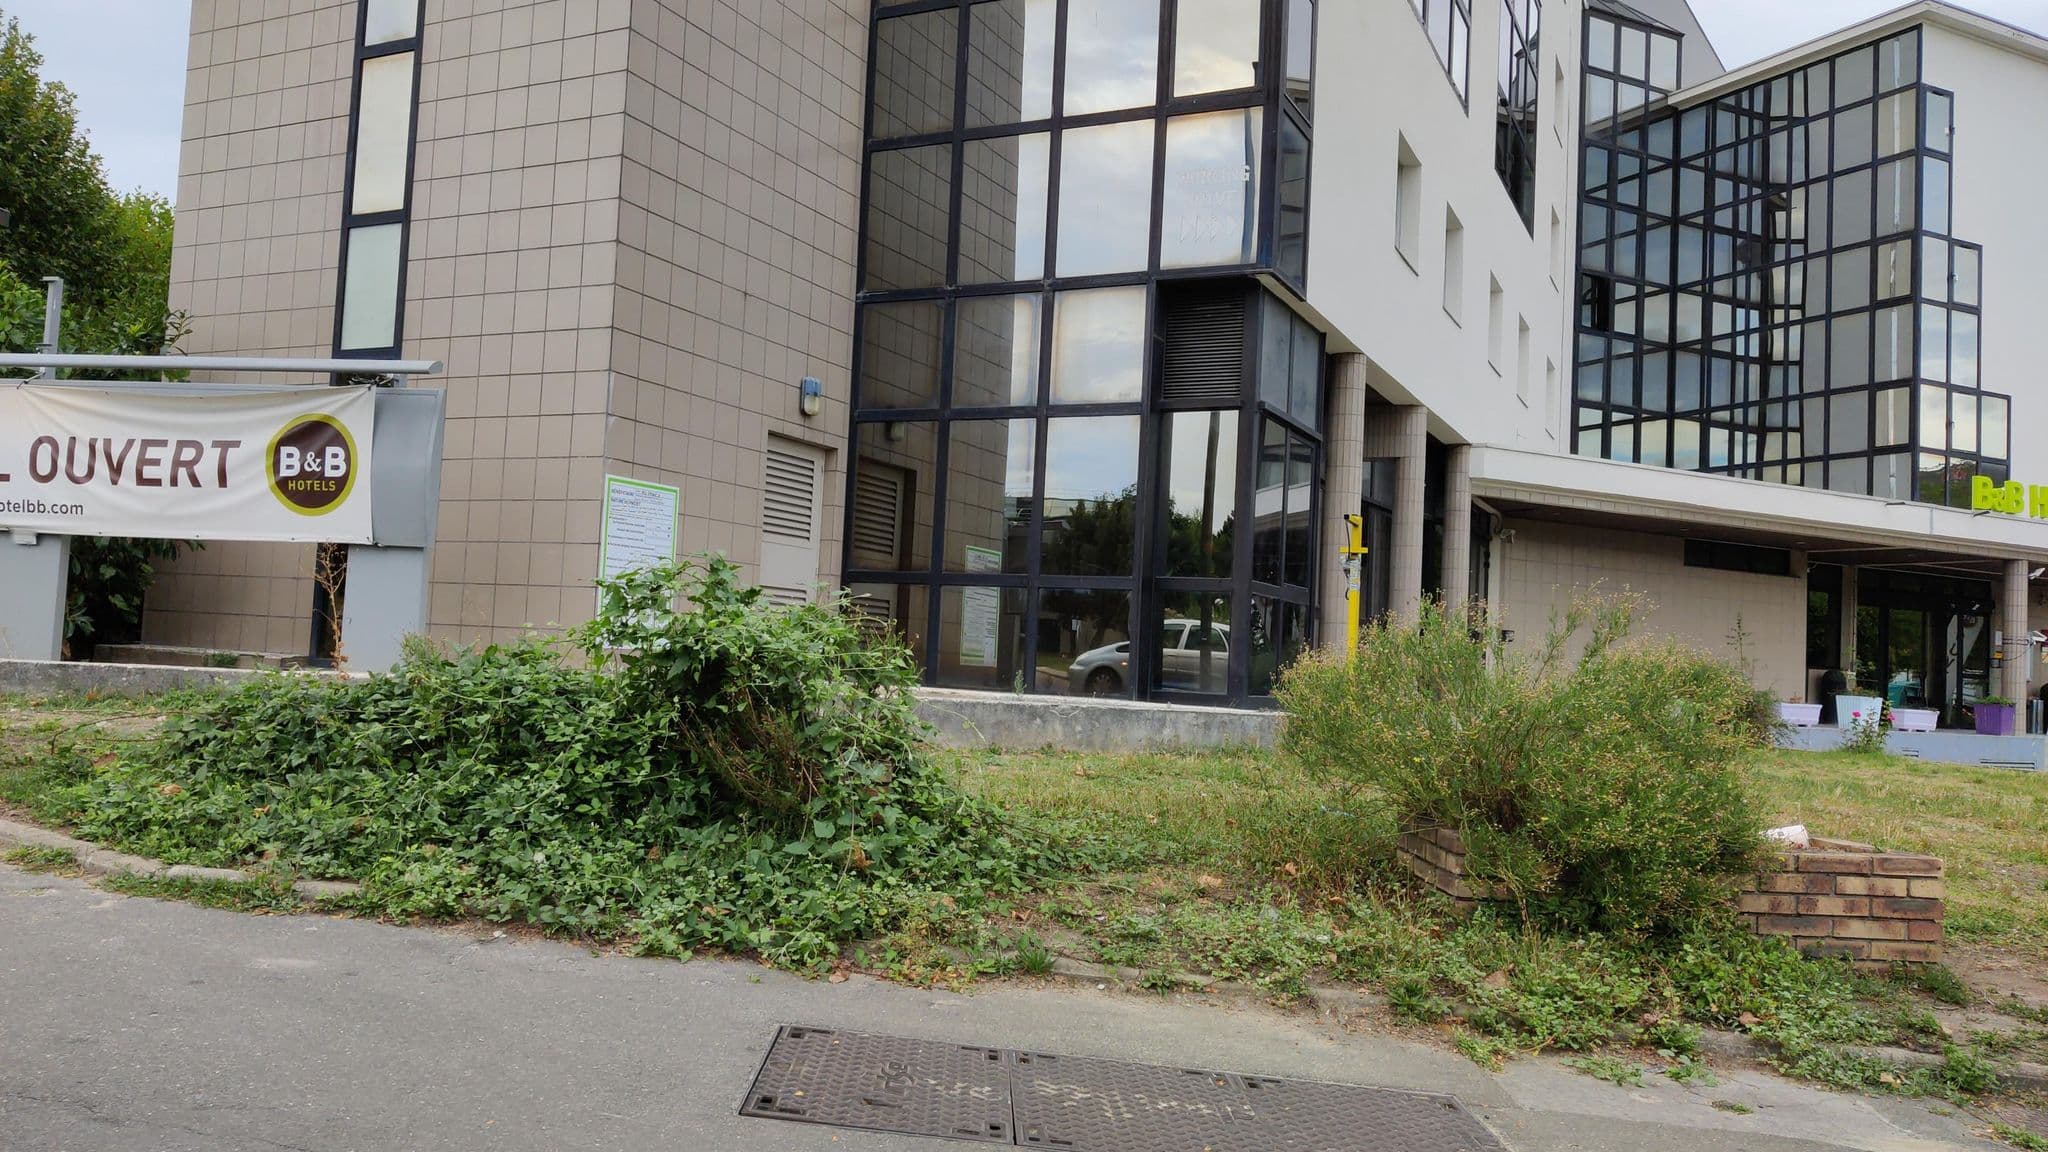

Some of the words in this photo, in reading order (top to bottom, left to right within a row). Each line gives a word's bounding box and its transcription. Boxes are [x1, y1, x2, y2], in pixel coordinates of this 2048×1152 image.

[29, 435, 242, 489] OUVERT
[279, 446, 347, 478] B&B
[287, 479, 336, 492] HOTELS
[1972, 475, 2024, 514] B&B
